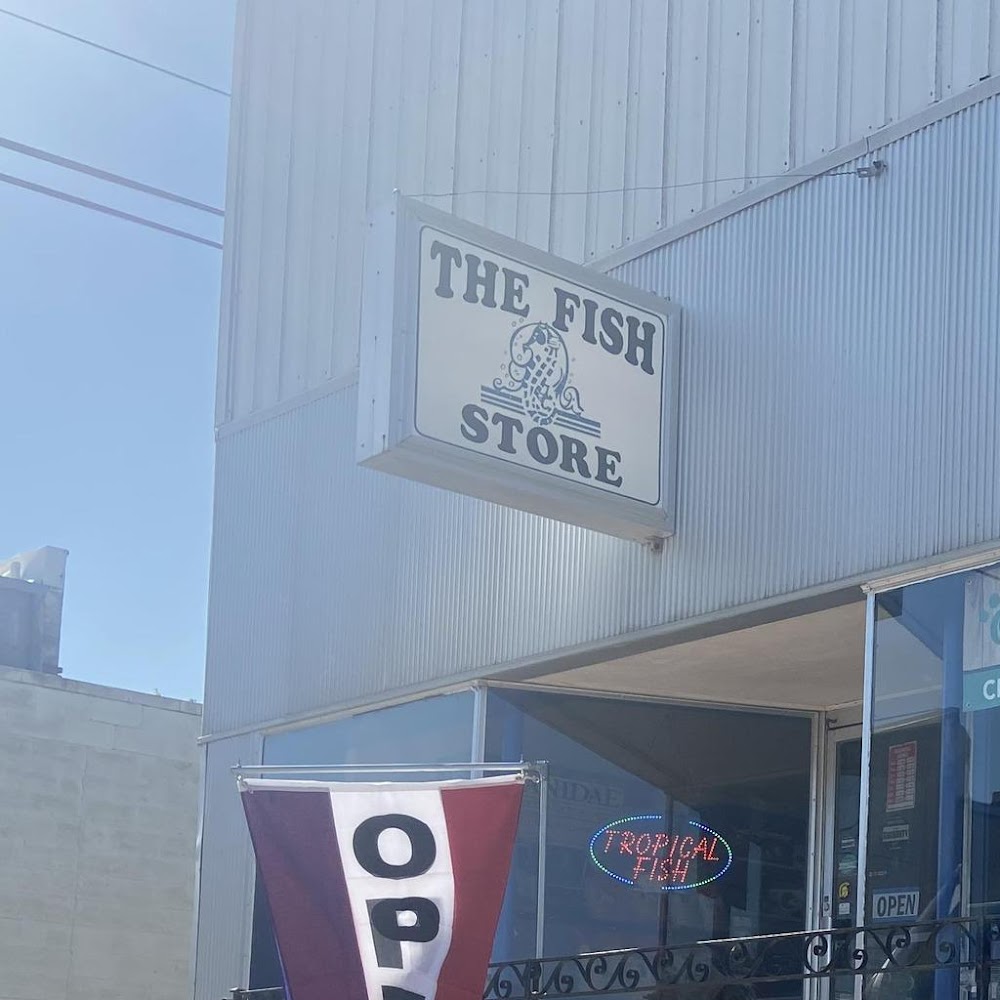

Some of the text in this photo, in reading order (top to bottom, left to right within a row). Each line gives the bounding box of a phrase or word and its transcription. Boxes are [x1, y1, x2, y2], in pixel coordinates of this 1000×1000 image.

[430, 240, 656, 375] THE FISH
[460, 403, 623, 488] STORE
[603, 829, 720, 861] TROPICAL
[632, 856, 690, 883] FISH
[876, 893, 917, 918] OPEN
